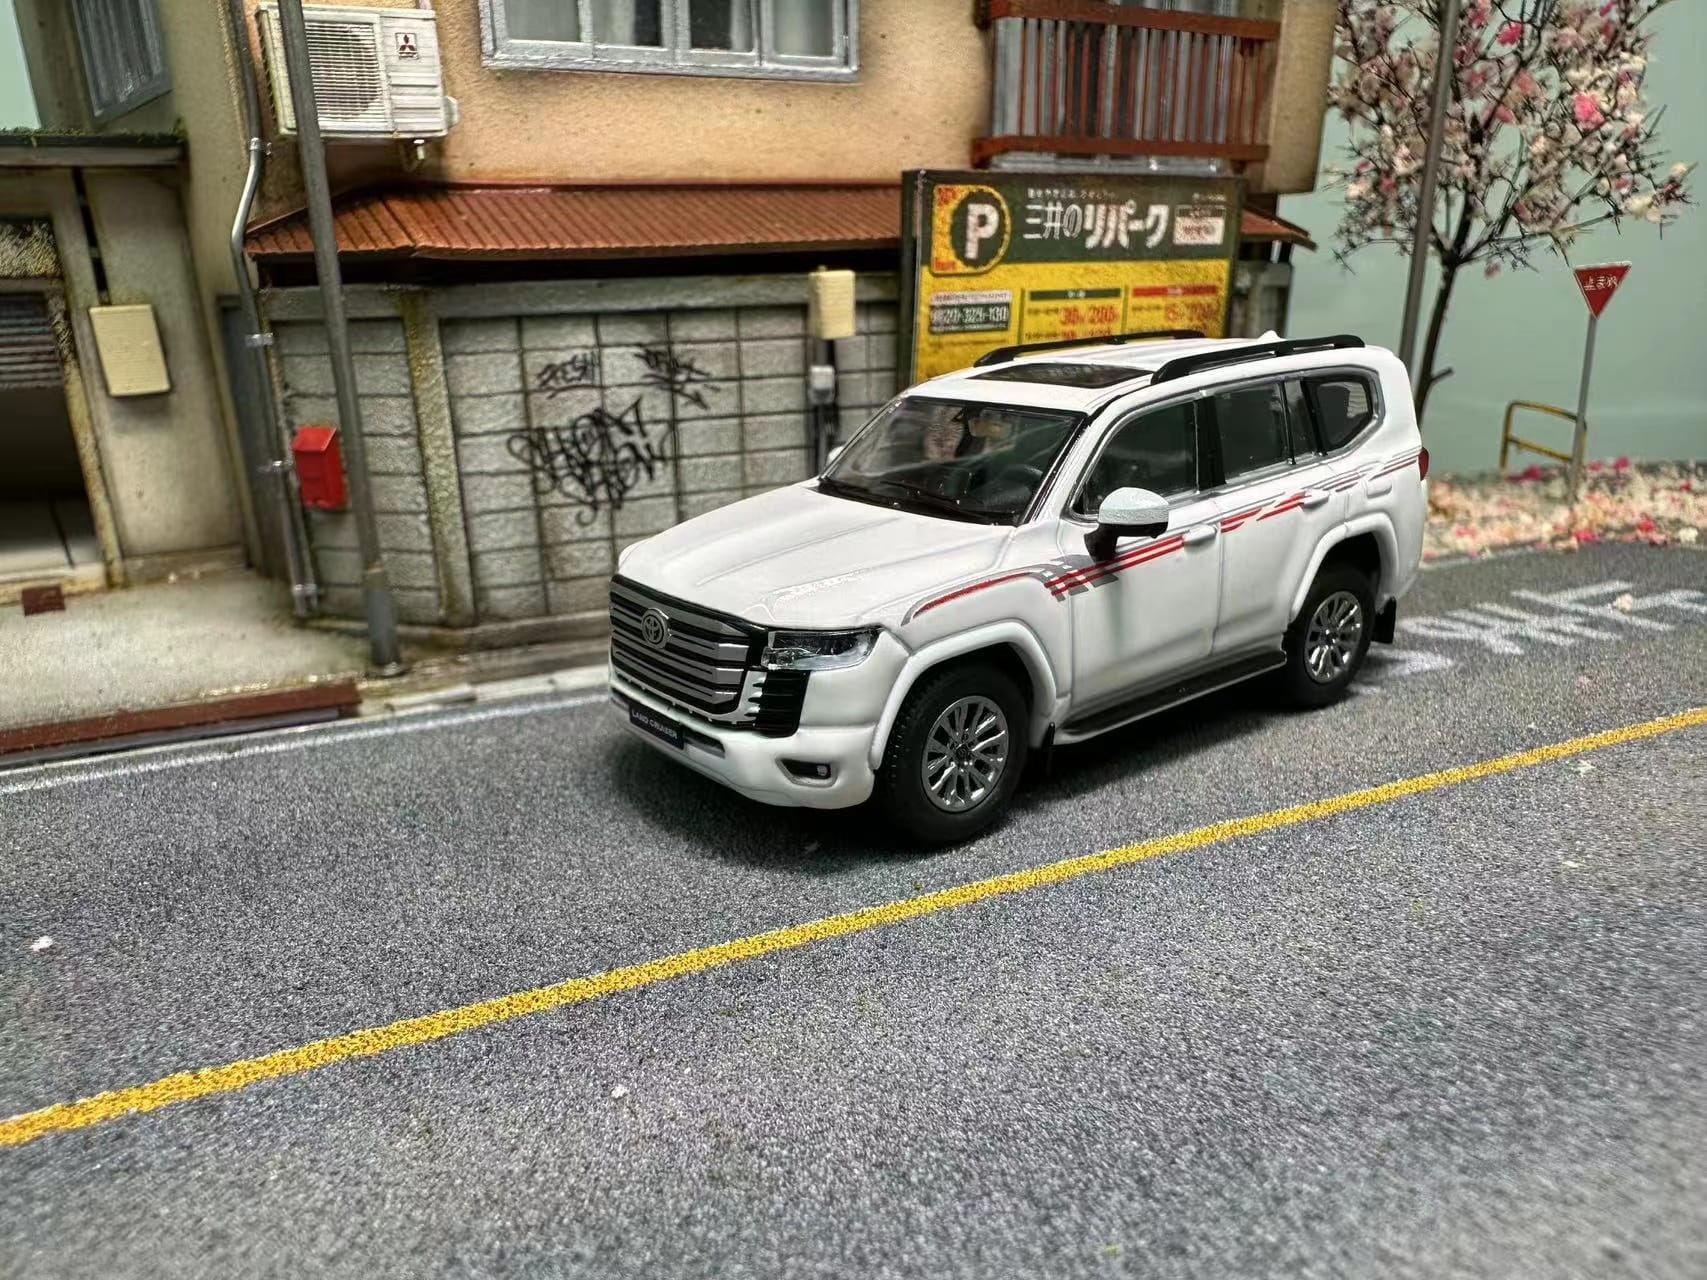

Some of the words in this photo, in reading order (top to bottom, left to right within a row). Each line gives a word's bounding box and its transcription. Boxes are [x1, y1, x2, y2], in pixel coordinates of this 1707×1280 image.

[965, 203, 999, 259] P
[1023, 199, 1169, 249] 三井のリパーク
[631, 709, 649, 724] LAND
